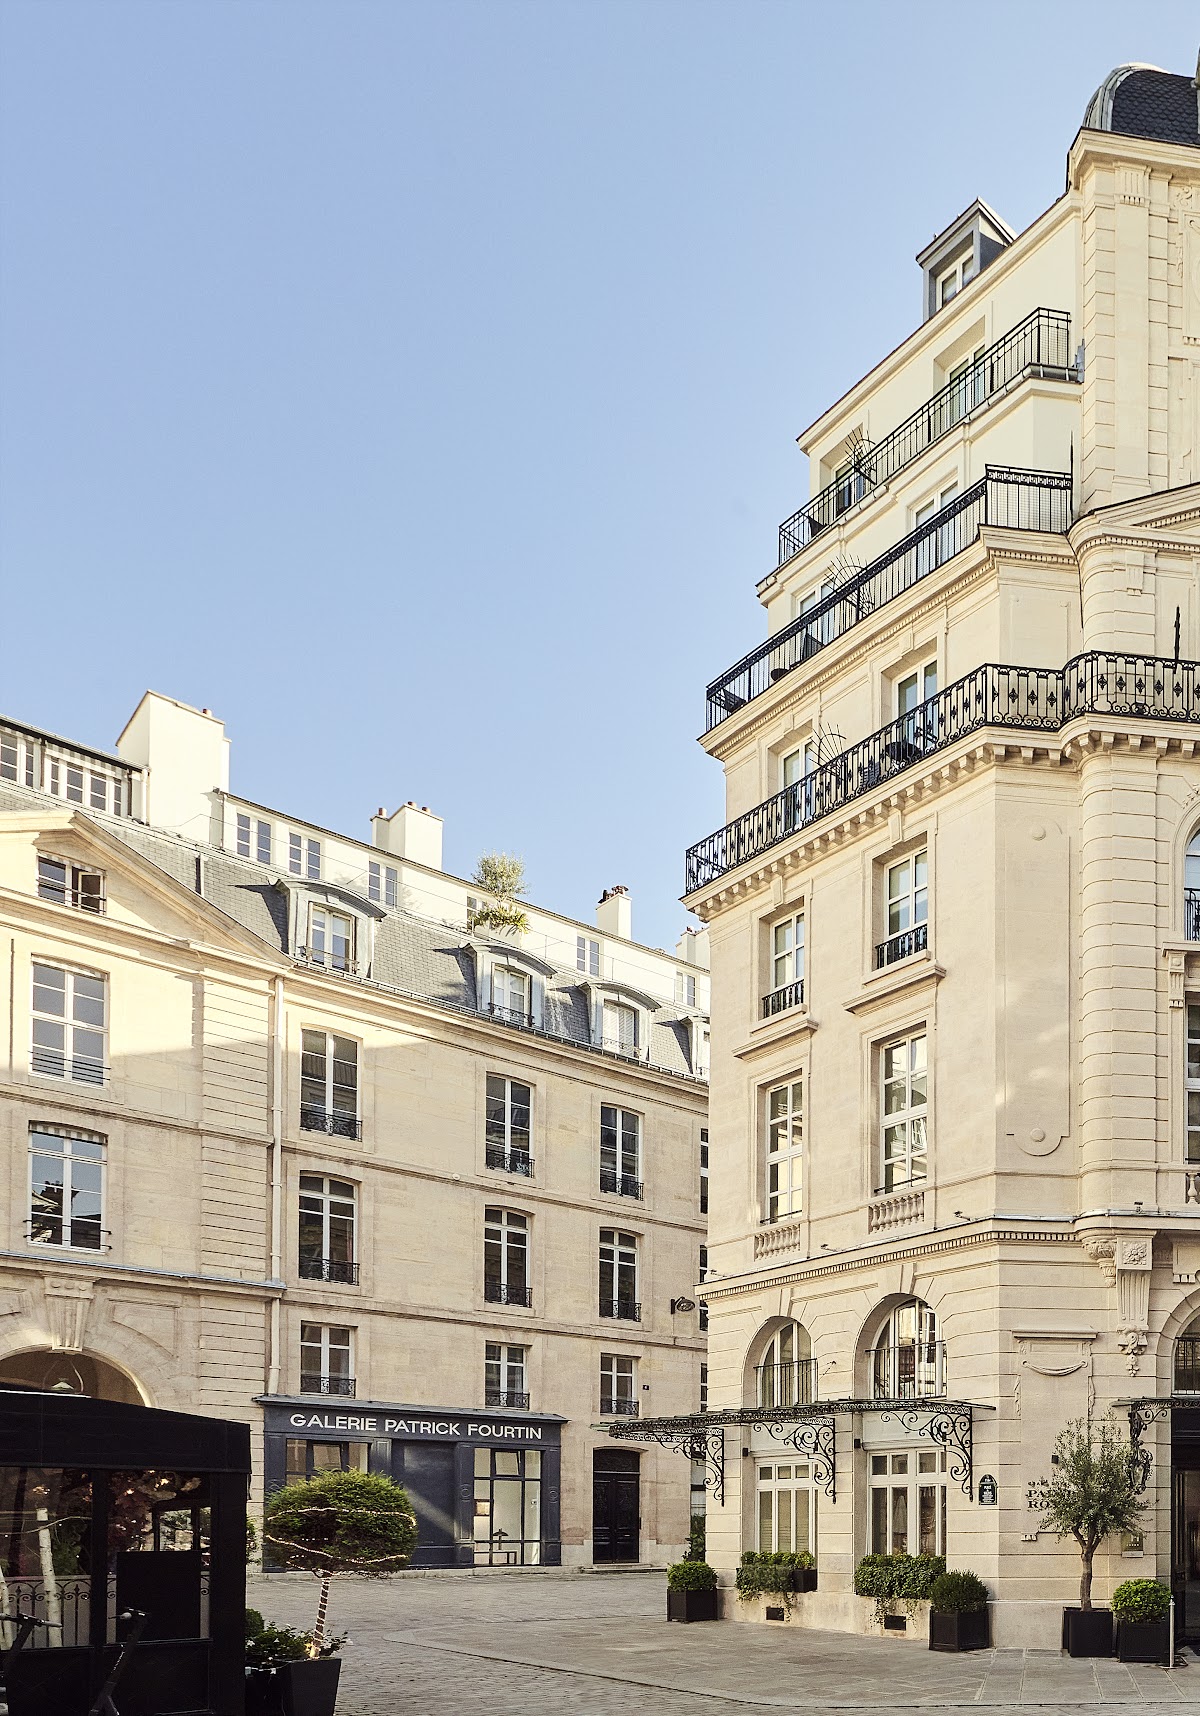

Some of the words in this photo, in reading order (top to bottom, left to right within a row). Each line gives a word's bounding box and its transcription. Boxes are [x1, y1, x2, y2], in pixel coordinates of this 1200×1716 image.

[289, 1413, 377, 1431] GALERIE
[384, 1419, 461, 1436] PATRICK
[467, 1423, 542, 1440] FOURTIN
